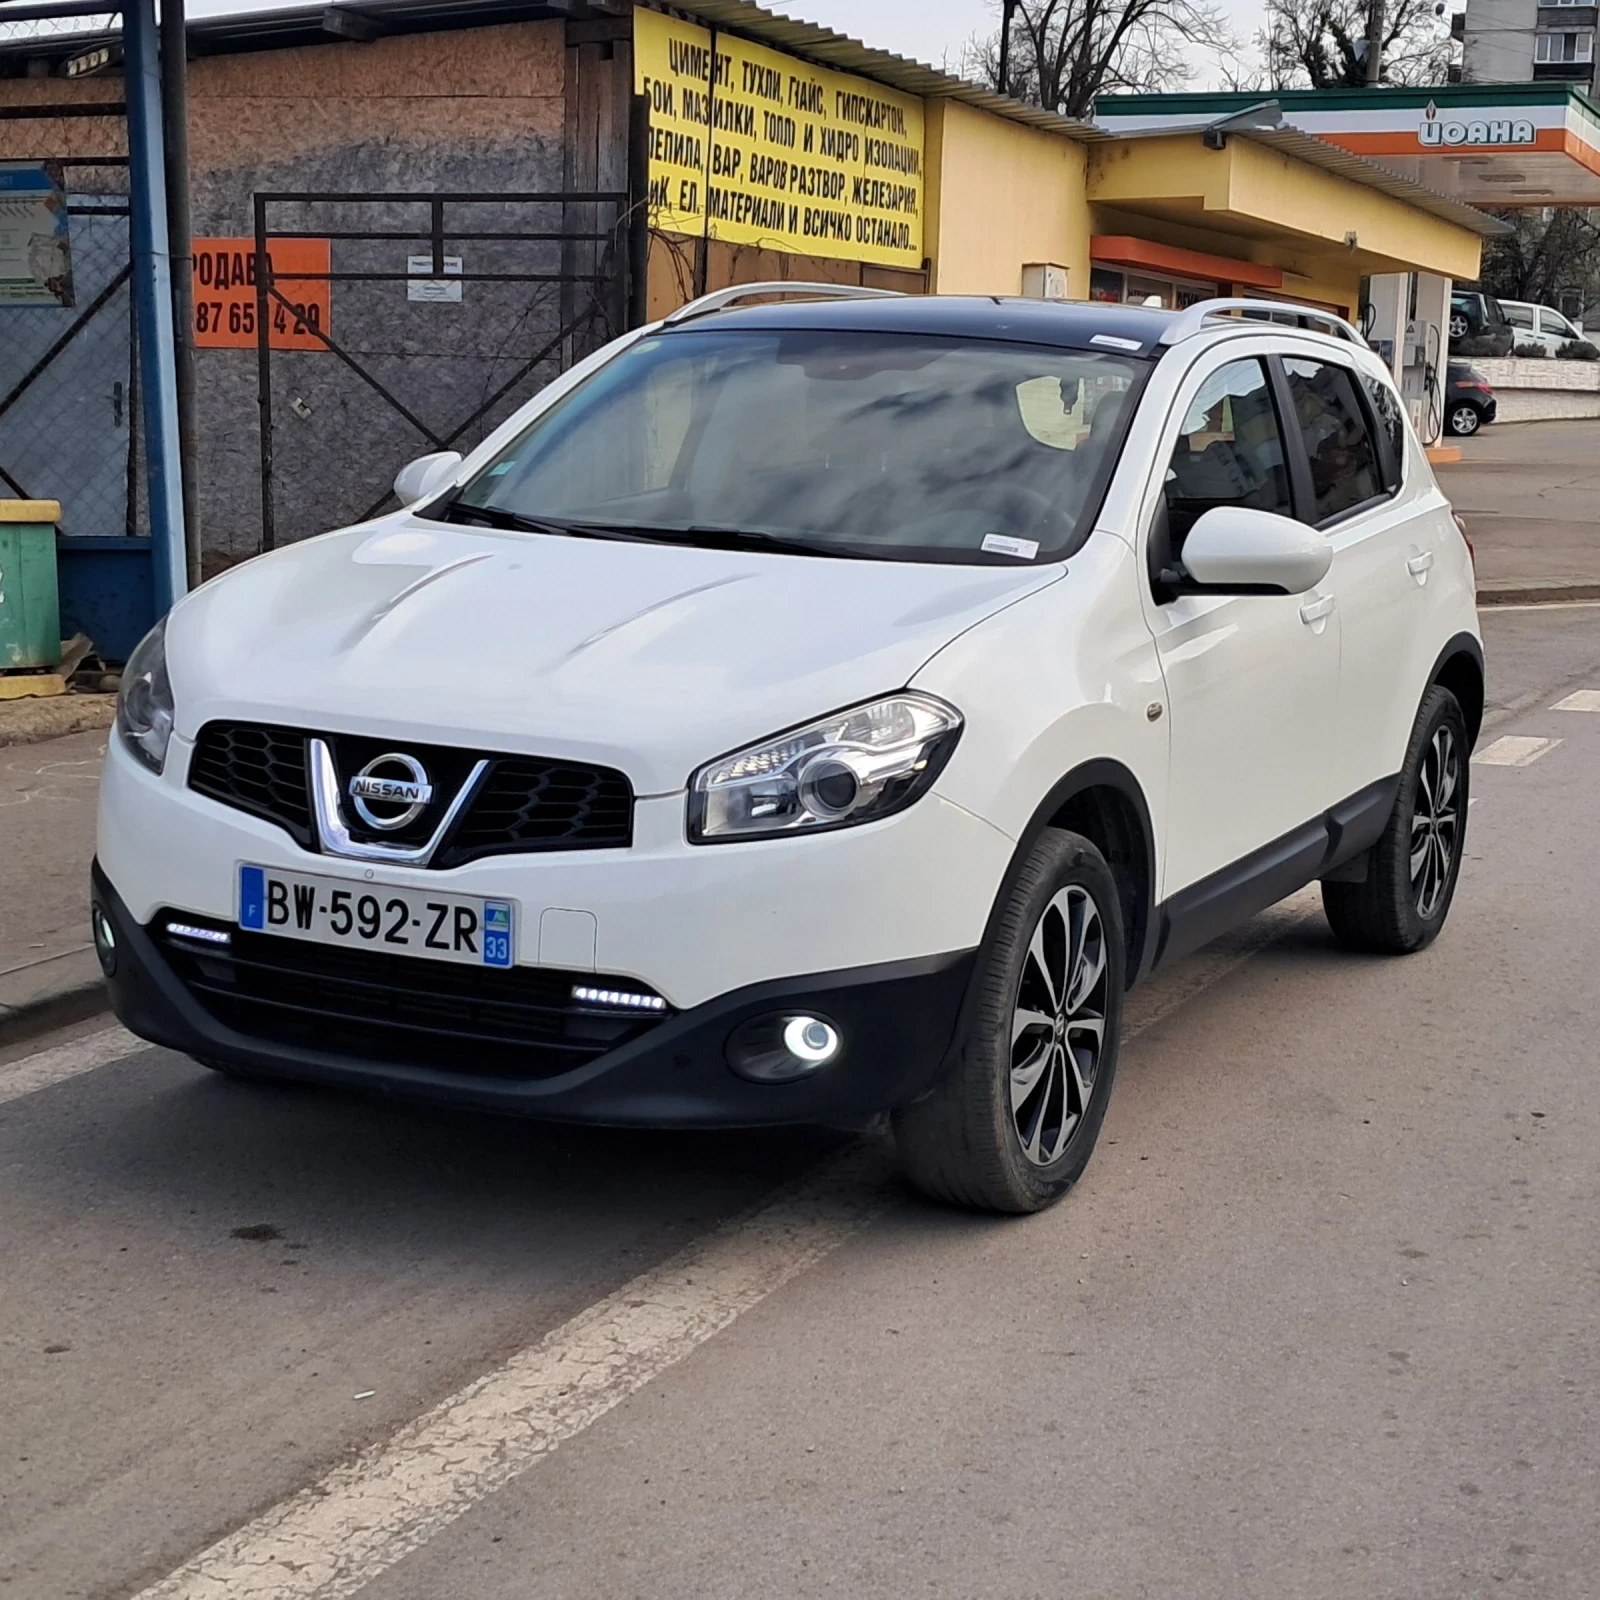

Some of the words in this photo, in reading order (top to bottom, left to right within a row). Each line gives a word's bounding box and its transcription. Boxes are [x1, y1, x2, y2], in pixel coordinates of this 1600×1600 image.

[669, 38, 735, 93] ЦИМЕНТ,
[742, 60, 784, 109] ТУХЛИ,
[835, 90, 907, 139] ГИПСКАРТОН,
[682, 87, 757, 143] МАЗИЛКИ,
[803, 122, 814, 153] И
[820, 125, 859, 163] ХИДРО
[865, 136, 922, 180] ИЗОЛАЦИИ,
[679, 179, 700, 215] ЕЛ.
[707, 186, 785, 232] МАТЕРИАЛИ
[788, 203, 798, 235] И
[803, 206, 852, 242] ВСИЧКО
[712, 143, 744, 186] ВАР,
[750, 152, 787, 192] ВАРОВ
[789, 163, 848, 207] РАЗТВОР,
[852, 175, 919, 218] ЖЕЛЕЗАРИЯ,
[353, 780, 420, 799] NISSAN
[248, 904, 257, 917] F
[267, 880, 480, 954] BW-592-ZR
[486, 936, 508, 959] 33
